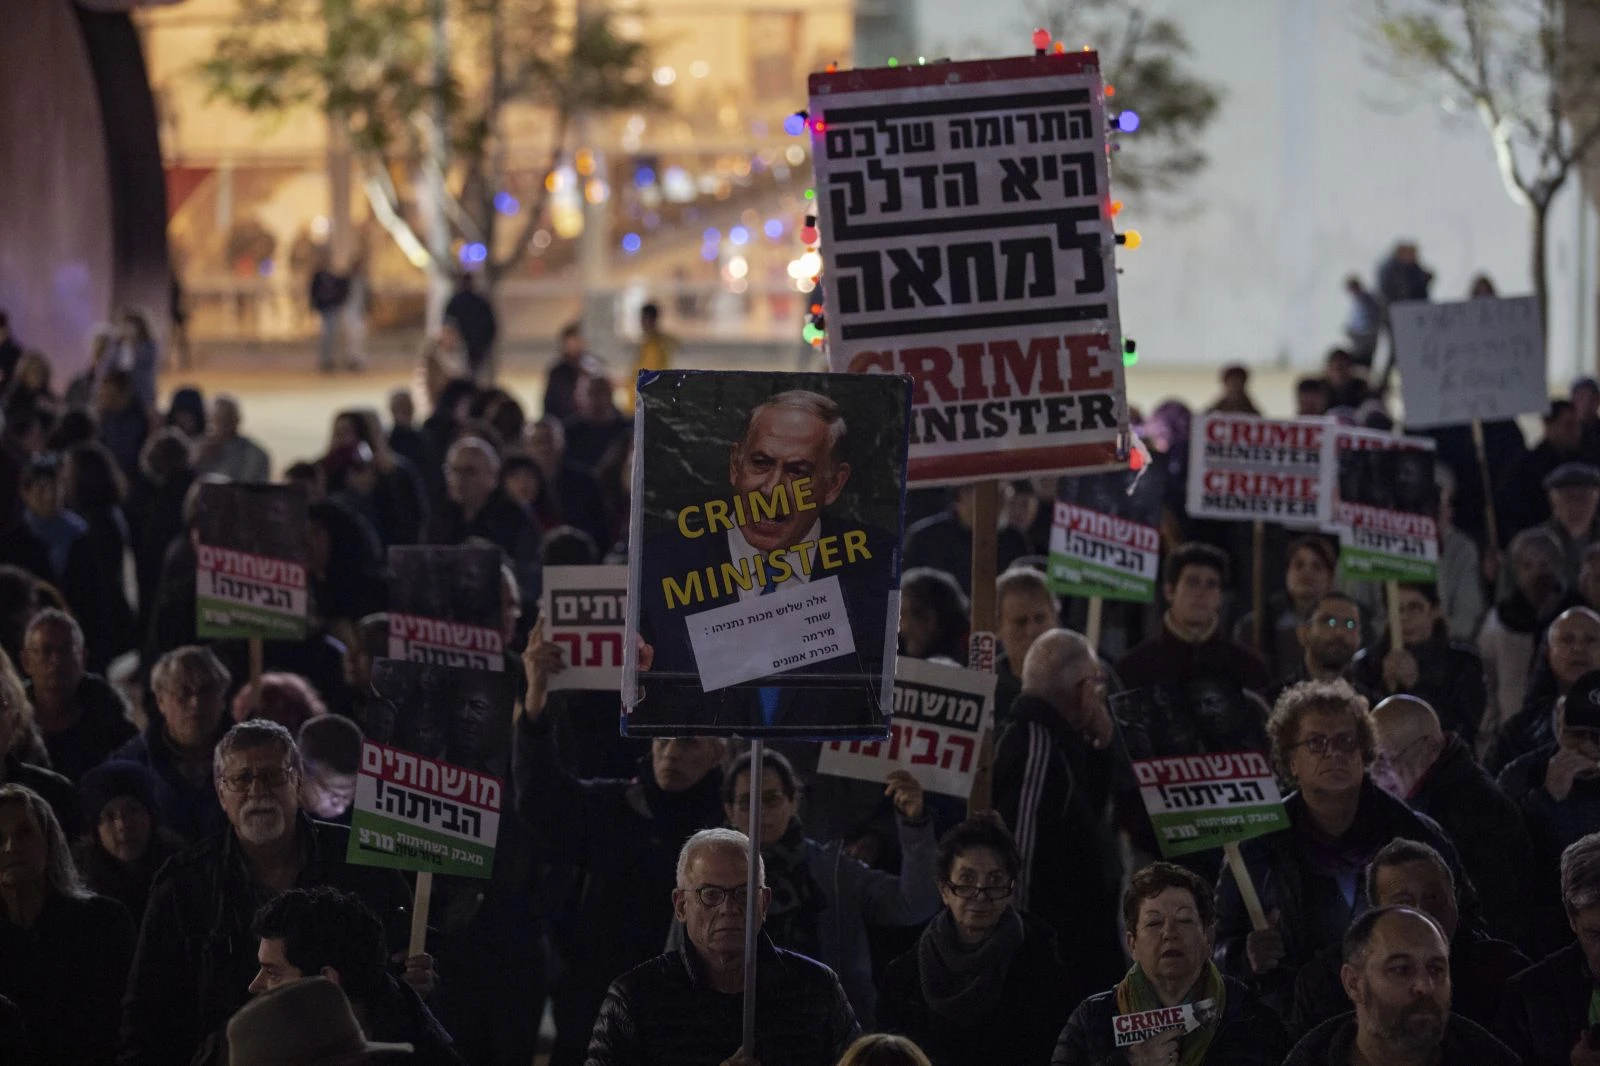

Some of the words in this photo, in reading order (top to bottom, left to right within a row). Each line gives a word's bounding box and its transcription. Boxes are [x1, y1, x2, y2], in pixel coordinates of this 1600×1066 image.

[825, 117, 935, 159] שלכם
[949, 110, 1093, 149] התרומה
[999, 152, 1098, 202] היא
[829, 160, 980, 235] הדלק
[836, 222, 1106, 313] למחאה
[1206, 420, 1322, 448] CRIME
[1203, 470, 1319, 499] CRIME
[676, 477, 817, 539] CRIME
[660, 529, 873, 610] MINISTER
[776, 602, 803, 616] שלוש
[805, 594, 828, 608] אלה
[711, 619, 745, 633] נתניהו
[747, 612, 773, 625] מכות
[804, 611, 831, 625] שוחד
[389, 612, 502, 653] מושחתים
[802, 627, 836, 643] מירמה
[772, 653, 807, 668] אמונים
[809, 643, 839, 658] הפרת
[362, 742, 501, 809] מושחתים
[1131, 752, 1270, 784] מושחתים
[375, 779, 481, 838] הביתה!
[1158, 781, 1265, 808] הביתה!
[451, 847, 484, 866] מאבק
[1116, 1007, 1186, 1032] CRIME
